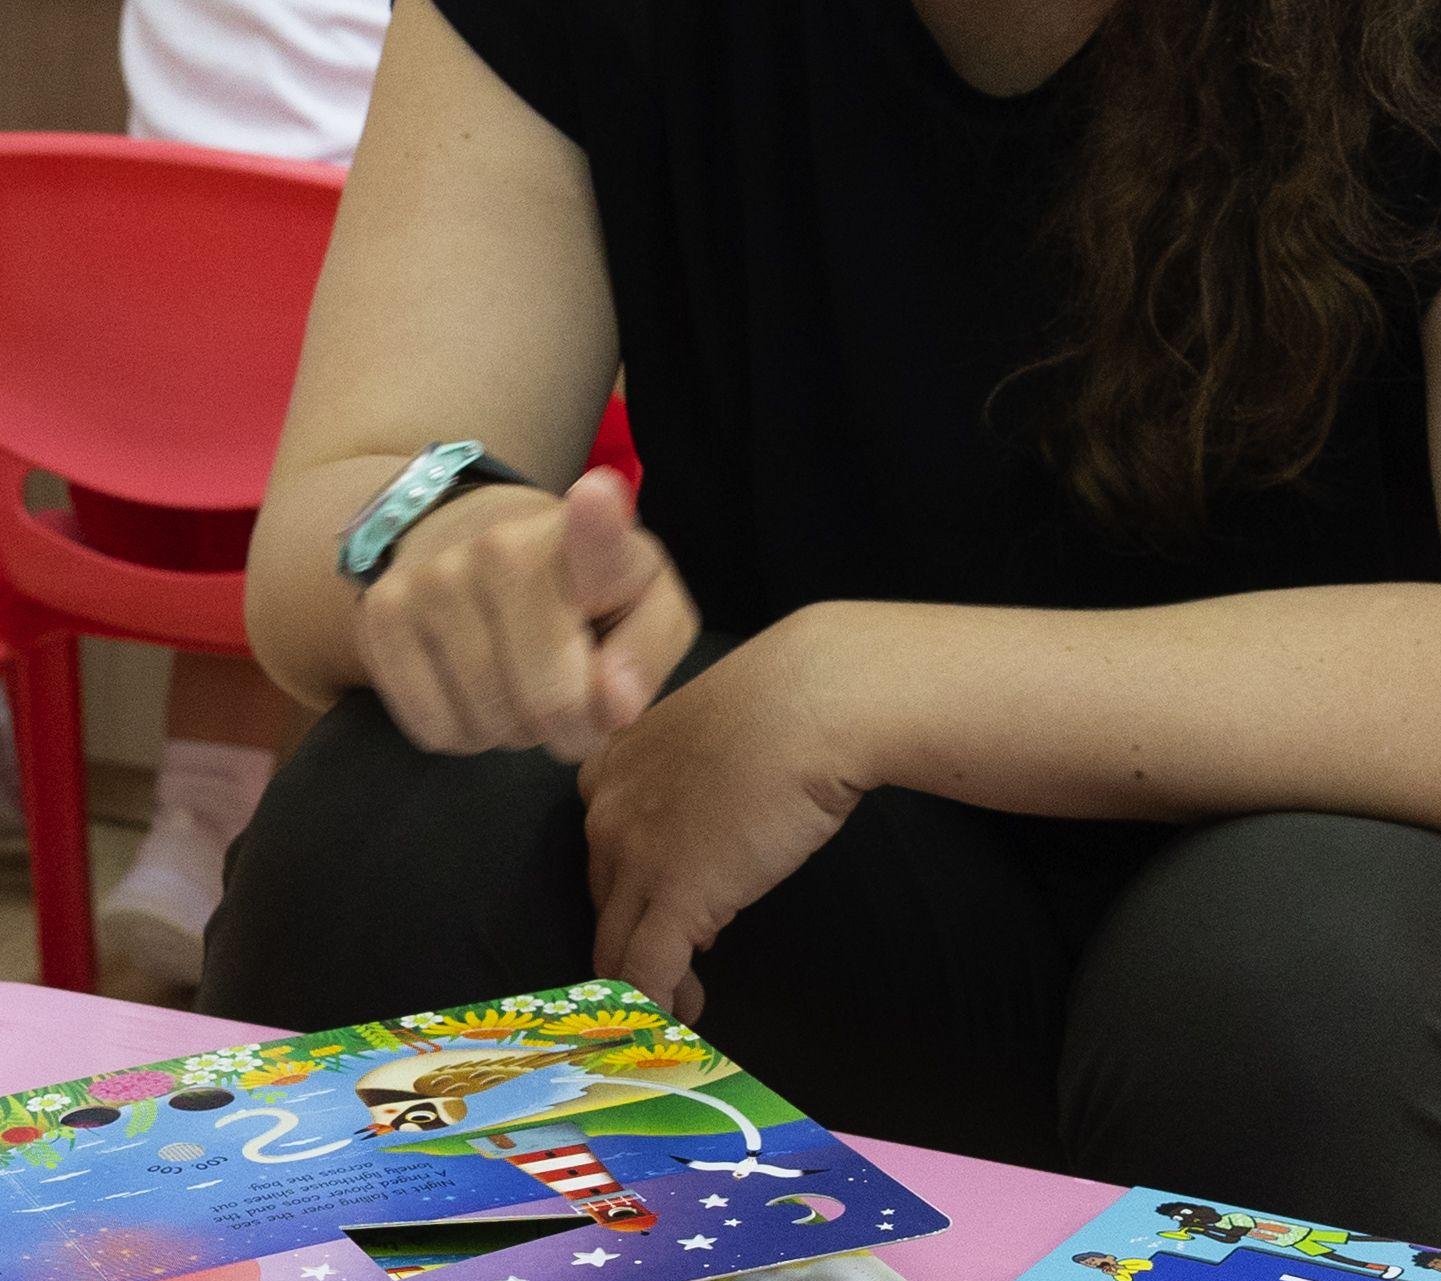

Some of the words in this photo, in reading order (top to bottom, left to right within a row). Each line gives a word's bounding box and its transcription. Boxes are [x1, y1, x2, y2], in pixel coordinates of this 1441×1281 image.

[147, 1165, 182, 1174] coo
[320, 1161, 373, 1175] across
[384, 1162, 433, 1176] lonely
[434, 1169, 447, 1179] A
[286, 1173, 313, 1184] the
[299, 1170, 381, 1190] lighthouse
[380, 1172, 430, 1187] ringed
[247, 1178, 282, 1193] bay.
[328, 1182, 373, 1198] plover
[414, 1179, 455, 1192] Night
[243, 1190, 294, 1205] shines
[339, 1190, 388, 1207] falling
[392, 1188, 406, 1198] is
[283, 1194, 320, 1205] coos
[209, 1201, 238, 1213] out
[247, 1204, 276, 1216] and
[302, 1203, 335, 1215] over
[213, 1213, 240, 1224] the
[268, 1213, 294, 1224] the
